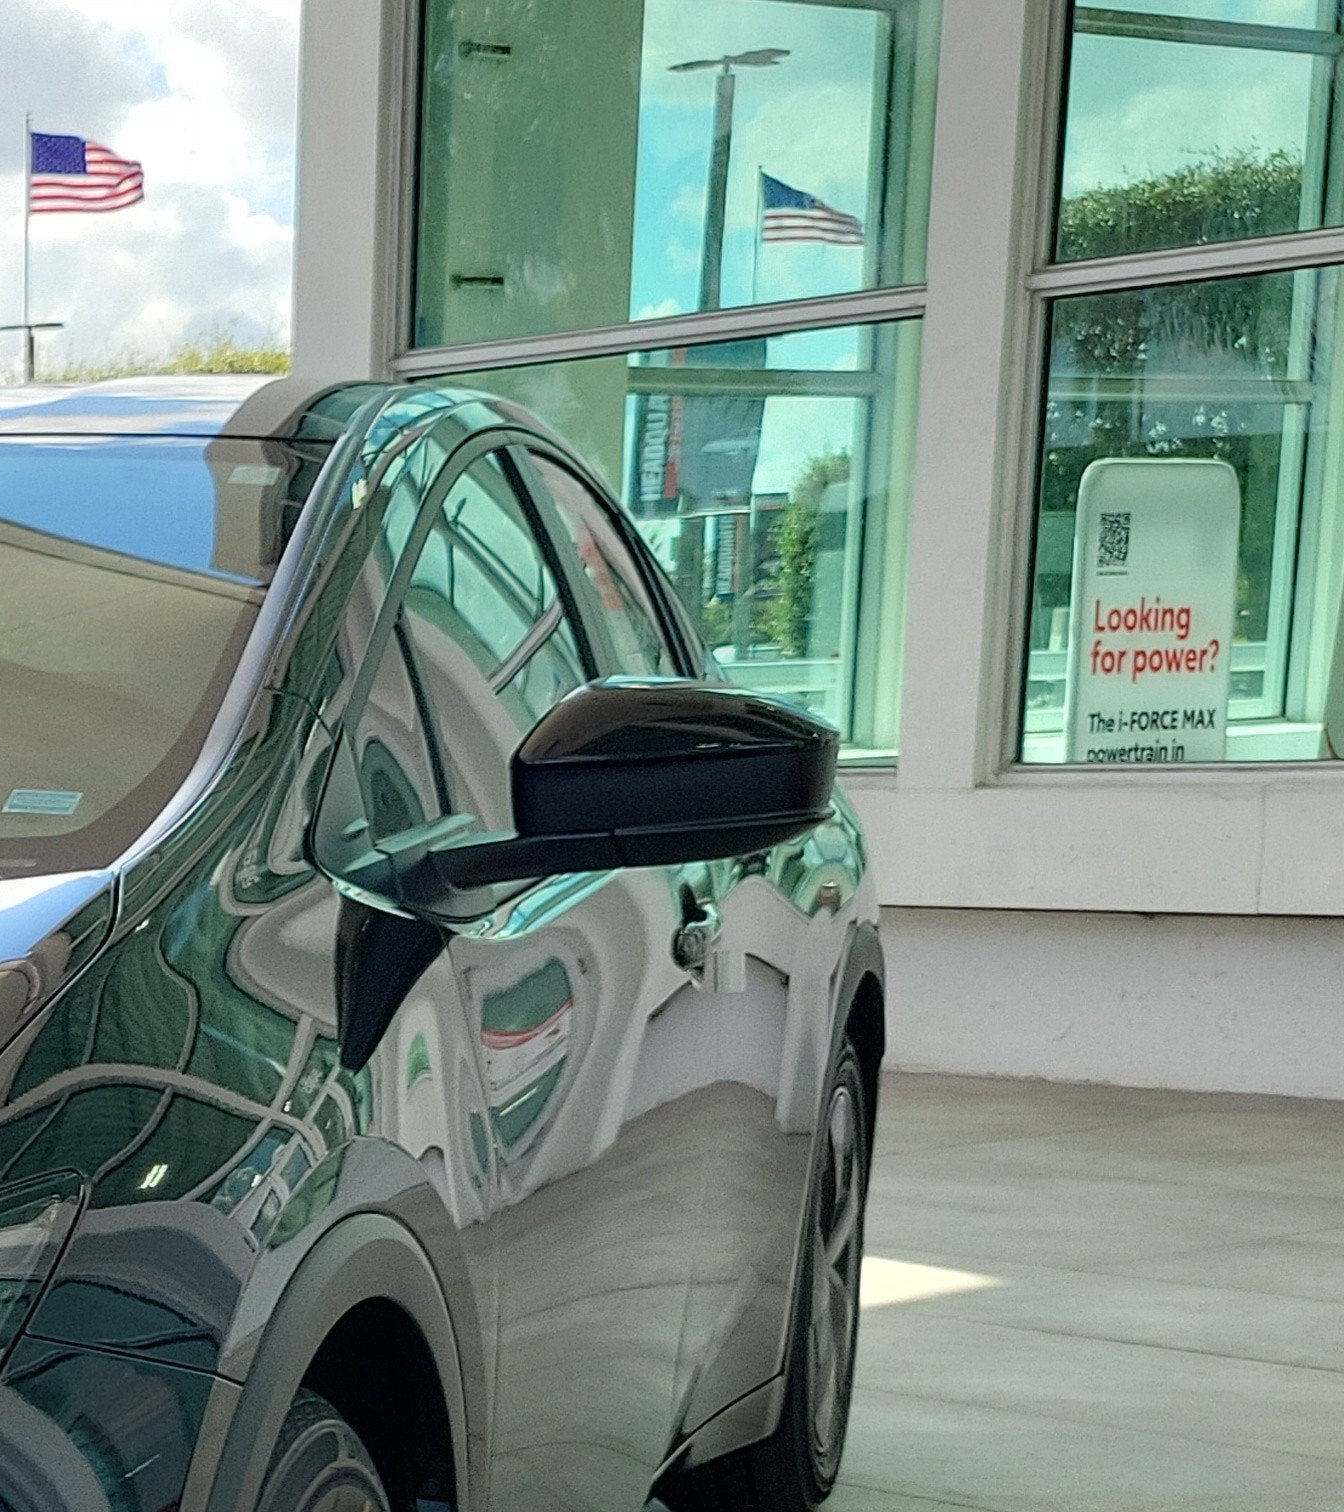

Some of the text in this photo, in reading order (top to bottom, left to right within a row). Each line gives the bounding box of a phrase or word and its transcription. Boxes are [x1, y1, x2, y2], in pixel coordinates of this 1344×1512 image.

[1093, 597, 1192, 640] Looking
[1091, 640, 1220, 683] for power?
[1088, 708, 1217, 733] The i-FORCE MAX
[1087, 738, 1185, 763] powertrain in
